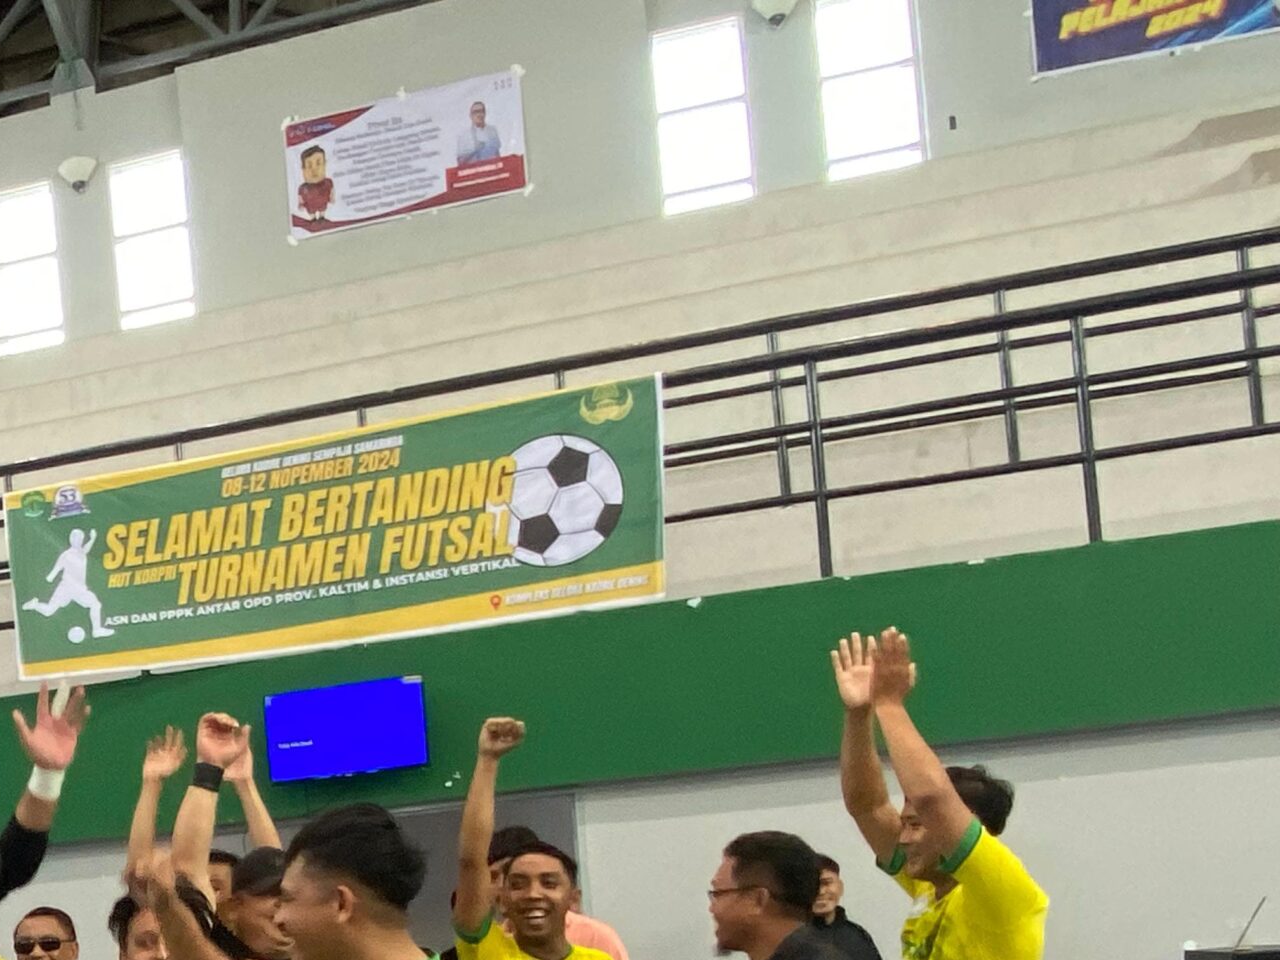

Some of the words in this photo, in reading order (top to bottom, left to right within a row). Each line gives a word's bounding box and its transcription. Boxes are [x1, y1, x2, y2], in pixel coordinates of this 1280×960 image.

[103, 498, 272, 570] SELAMAT
[278, 456, 517, 541] BERTANDING
[222, 472, 267, 497] 08-12
[270, 456, 354, 489] NOPEMBER
[357, 448, 401, 474] 2024
[104, 615, 129, 627] ASN
[131, 612, 157, 624] DAN
[159, 607, 194, 621] PPPK
[196, 602, 240, 616] ANTAR
[243, 596, 272, 609] OPD
[275, 589, 316, 605] PROV.
[319, 580, 370, 598] KALTIM
[372, 578, 383, 589] &
[385, 567, 450, 588] INSTANSI
[450, 557, 520, 576] VERTIKAL
[108, 571, 130, 588] HUT
[133, 564, 177, 586] KORPRI
[177, 532, 372, 605] TURNAMEN
[379, 508, 515, 575] FUTSAL
